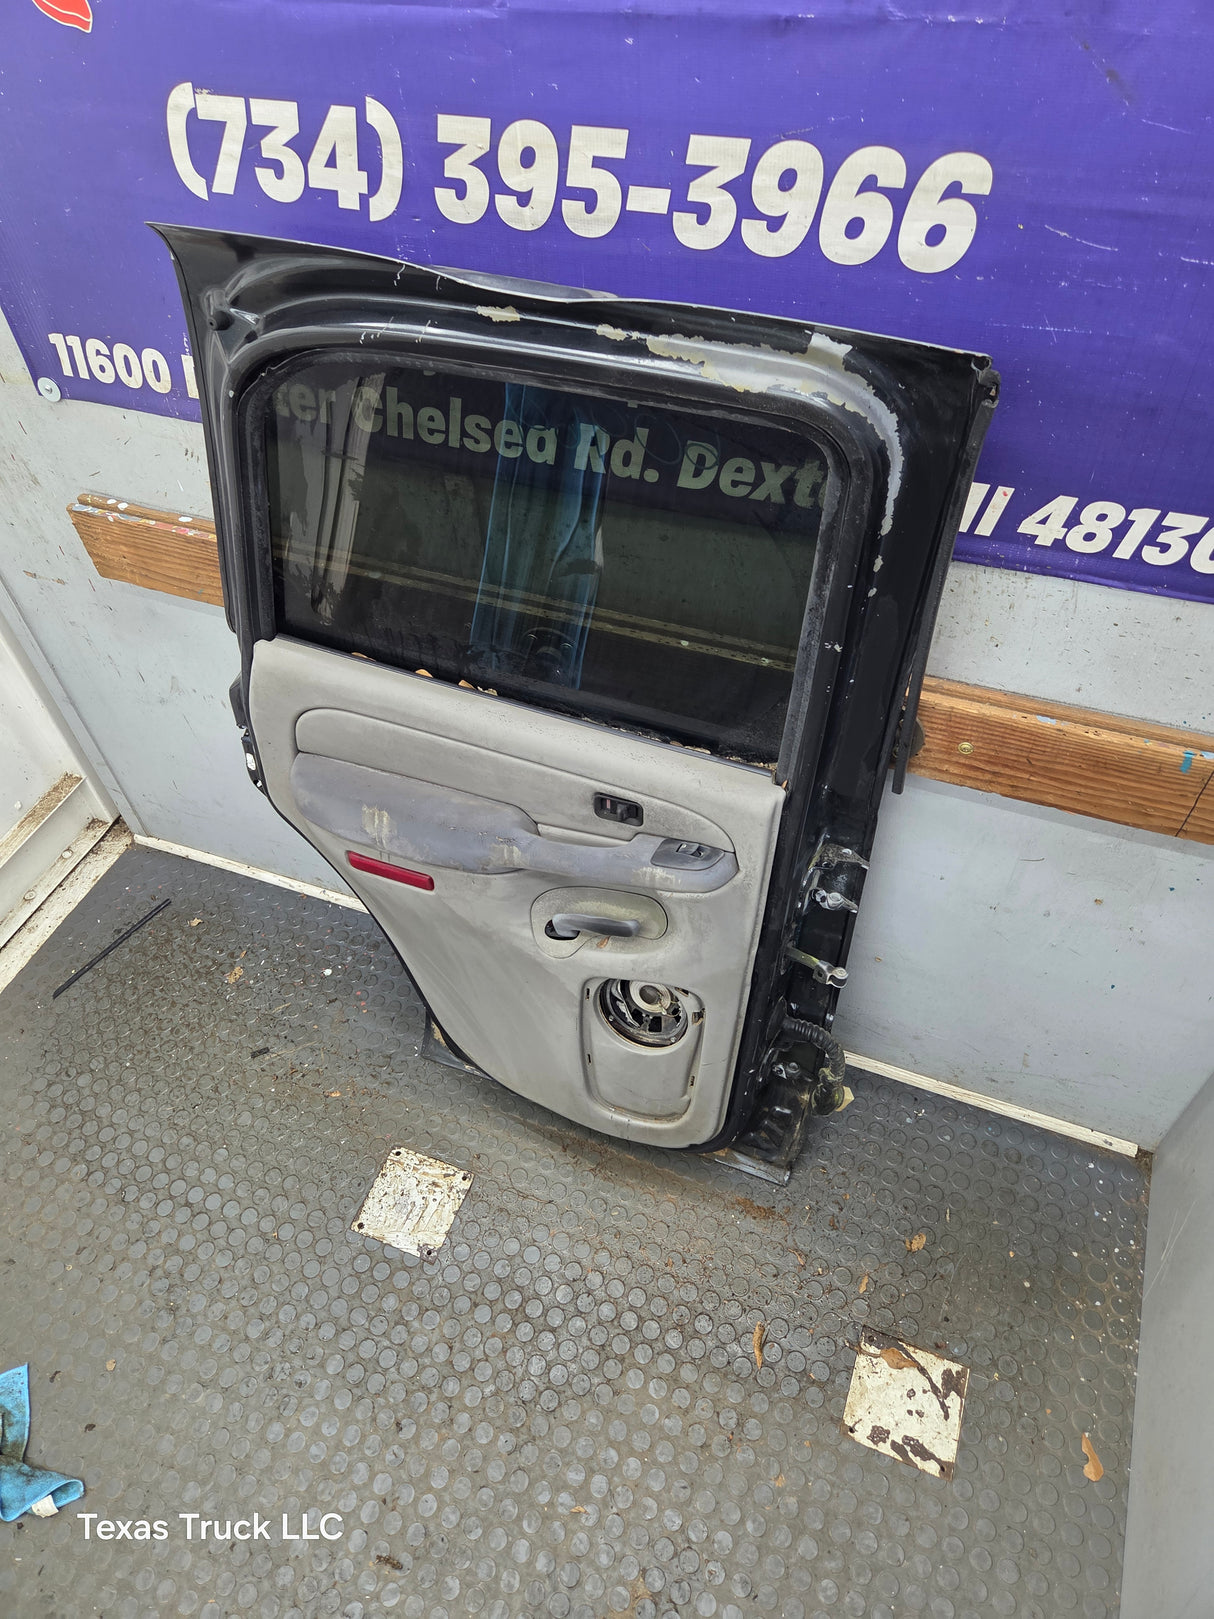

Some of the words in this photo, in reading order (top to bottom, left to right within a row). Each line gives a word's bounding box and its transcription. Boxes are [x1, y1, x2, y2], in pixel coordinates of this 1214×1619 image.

[167, 81, 404, 222] (734)
[433, 113, 994, 274] 395-3966
[48, 332, 172, 394] 11600
[353, 386, 560, 466] Chelsea
[574, 422, 660, 483] Rd.
